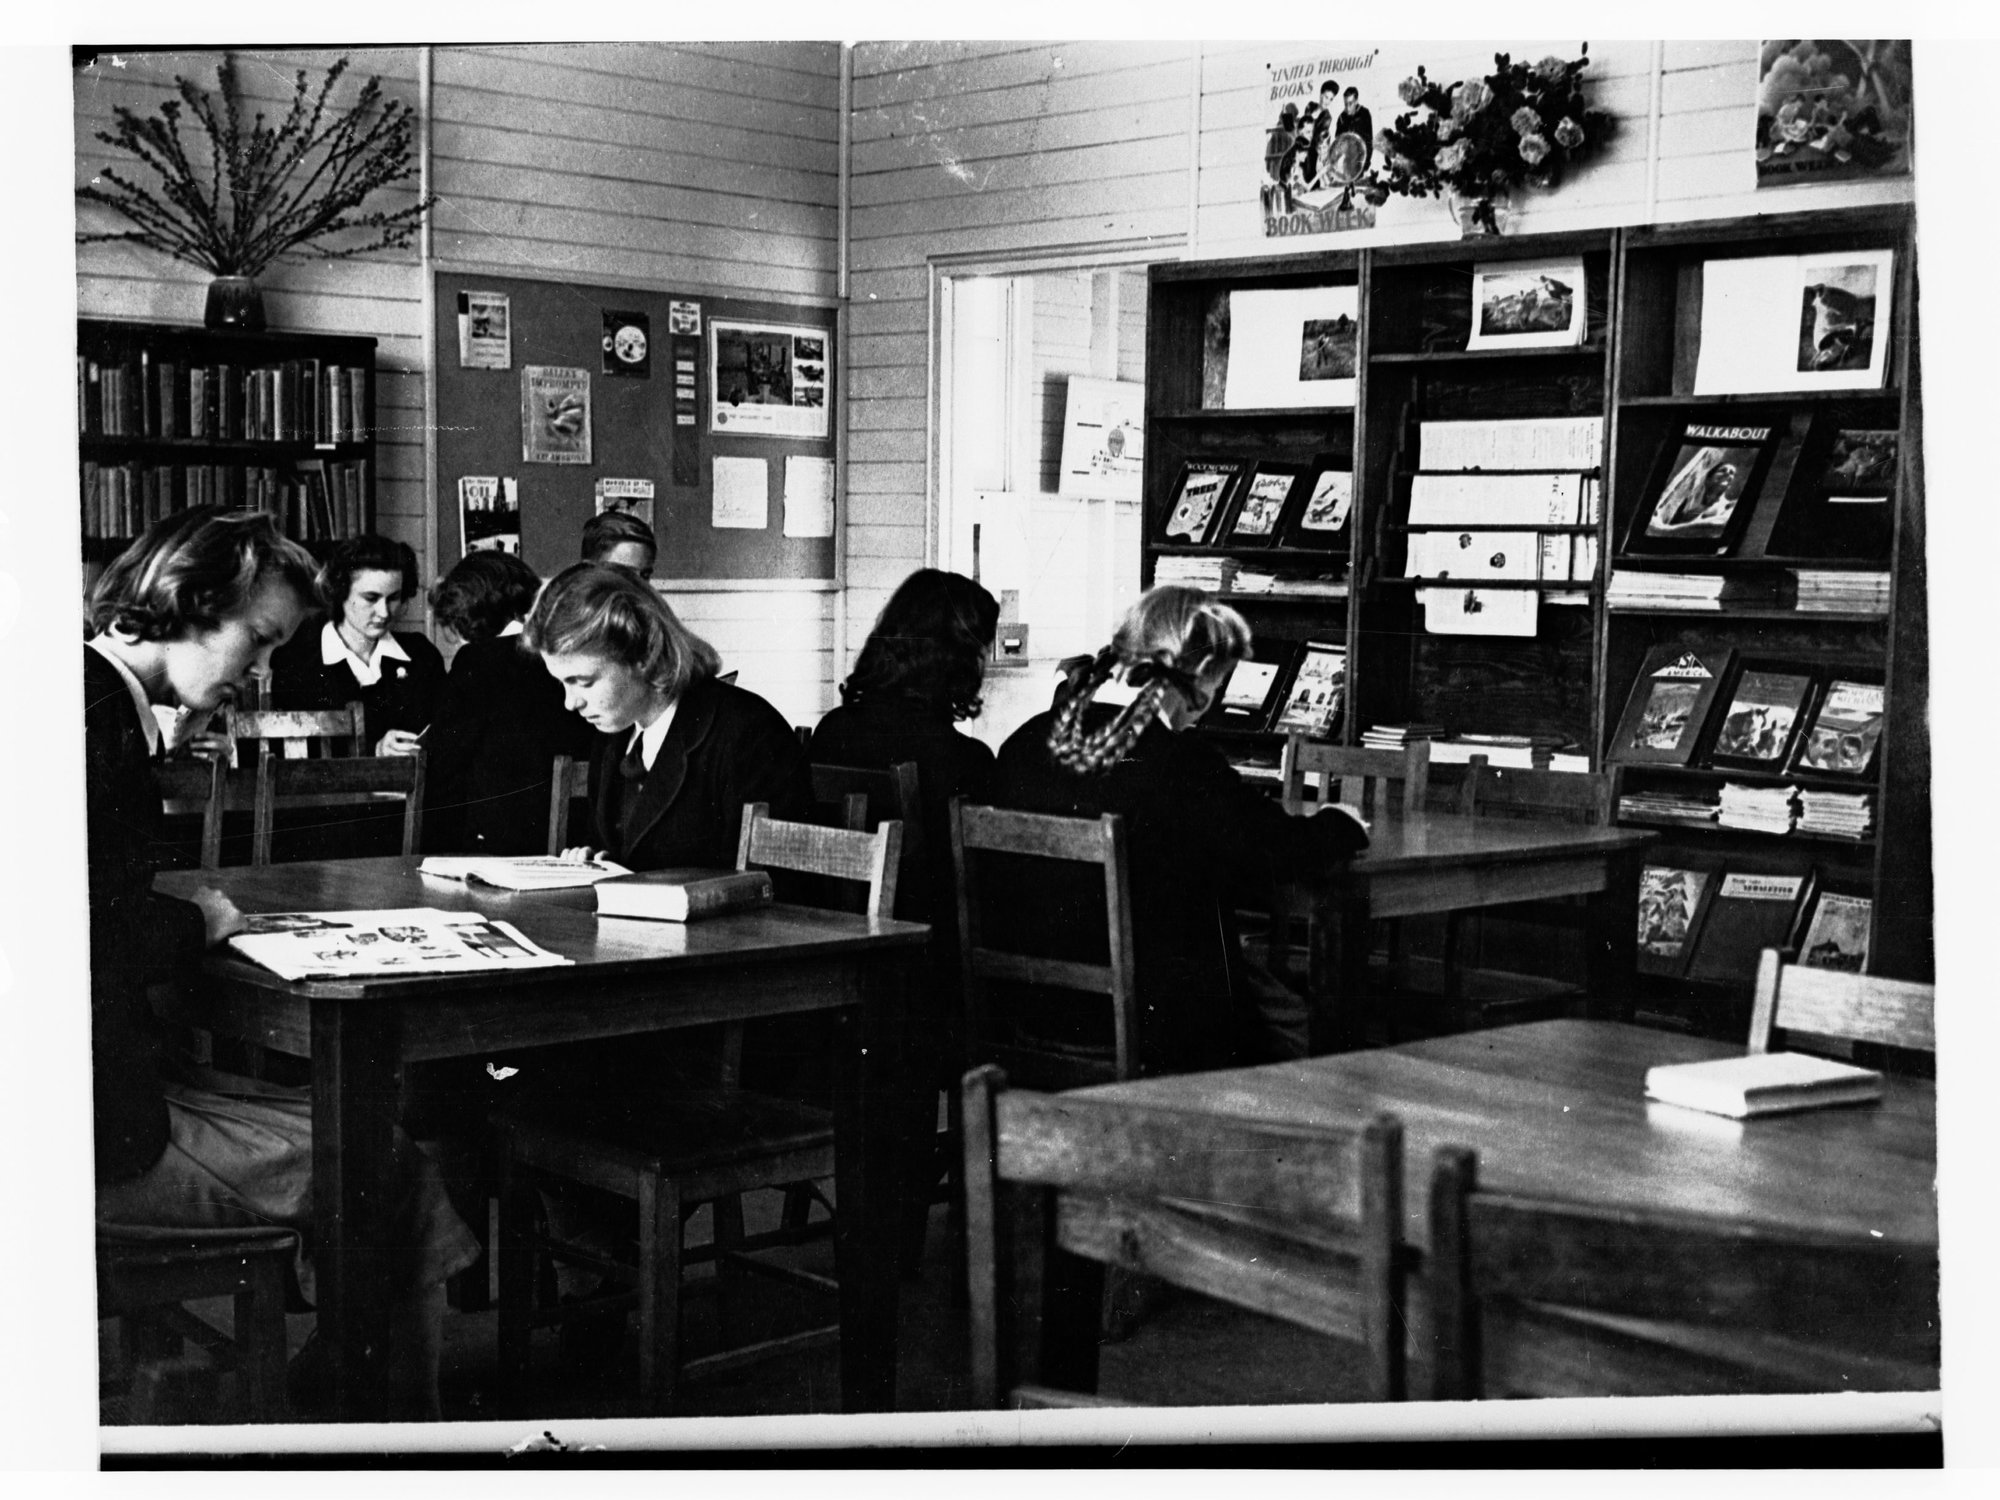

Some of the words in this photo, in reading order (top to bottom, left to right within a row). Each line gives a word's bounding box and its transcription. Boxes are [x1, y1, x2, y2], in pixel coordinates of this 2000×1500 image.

[1270, 80, 1313, 101] BOOKS
[1759, 163, 1793, 176] BOOK
[1265, 213, 1312, 237] BOOK
[1318, 207, 1371, 232] WEEK
[1684, 424, 1771, 441] WALKABOUT
[469, 486, 491, 498] OIL
[1186, 482, 1218, 497] TREES
